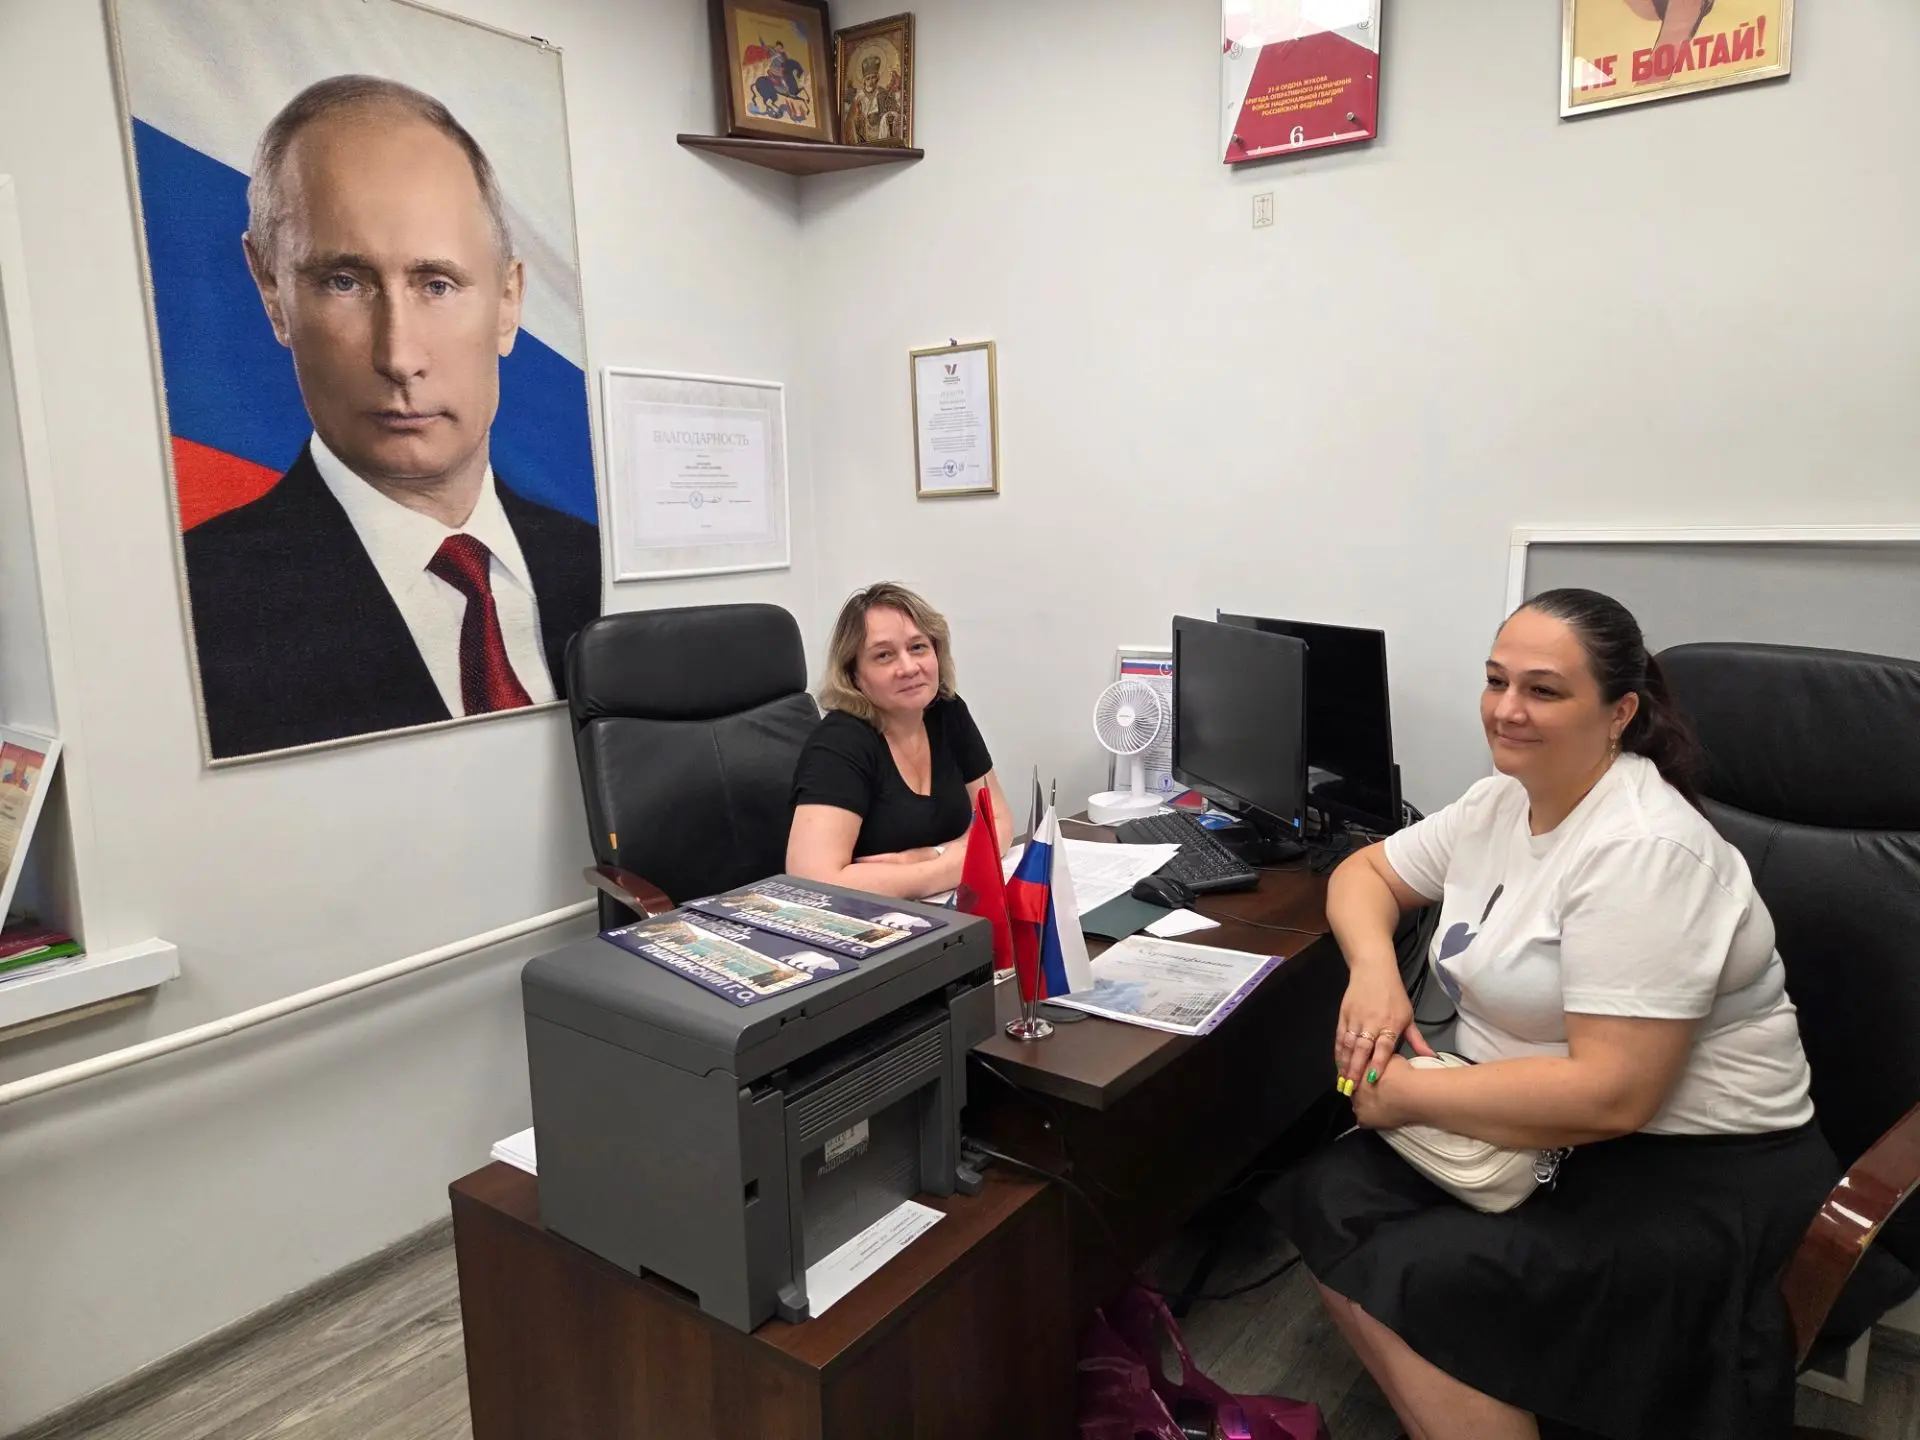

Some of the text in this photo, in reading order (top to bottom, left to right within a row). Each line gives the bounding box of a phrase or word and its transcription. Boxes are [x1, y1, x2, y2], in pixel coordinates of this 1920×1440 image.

[1632, 15, 1766, 82] БОЛТАЙ!
[1245, 78, 1352, 105] БРИГАДА ОПЕРАТИВНОГО НАЗНАЧЕНИЯ
[1280, 80, 1303, 91] ОРДЕНА
[1304, 75, 1328, 86] ЖУКОВА
[1262, 97, 1333, 116] РОССИЙСКОЙ ФЕДЕРАЦИИ
[1271, 92, 1317, 107] НАЦИОНАЛЬНОЙ
[1318, 87, 1344, 98] ГВАРДИИ
[1289, 125, 1304, 148] 6
[653, 430, 750, 447] БЛАГОДАРНОСТЬ
[677, 911, 707, 925] КТО
